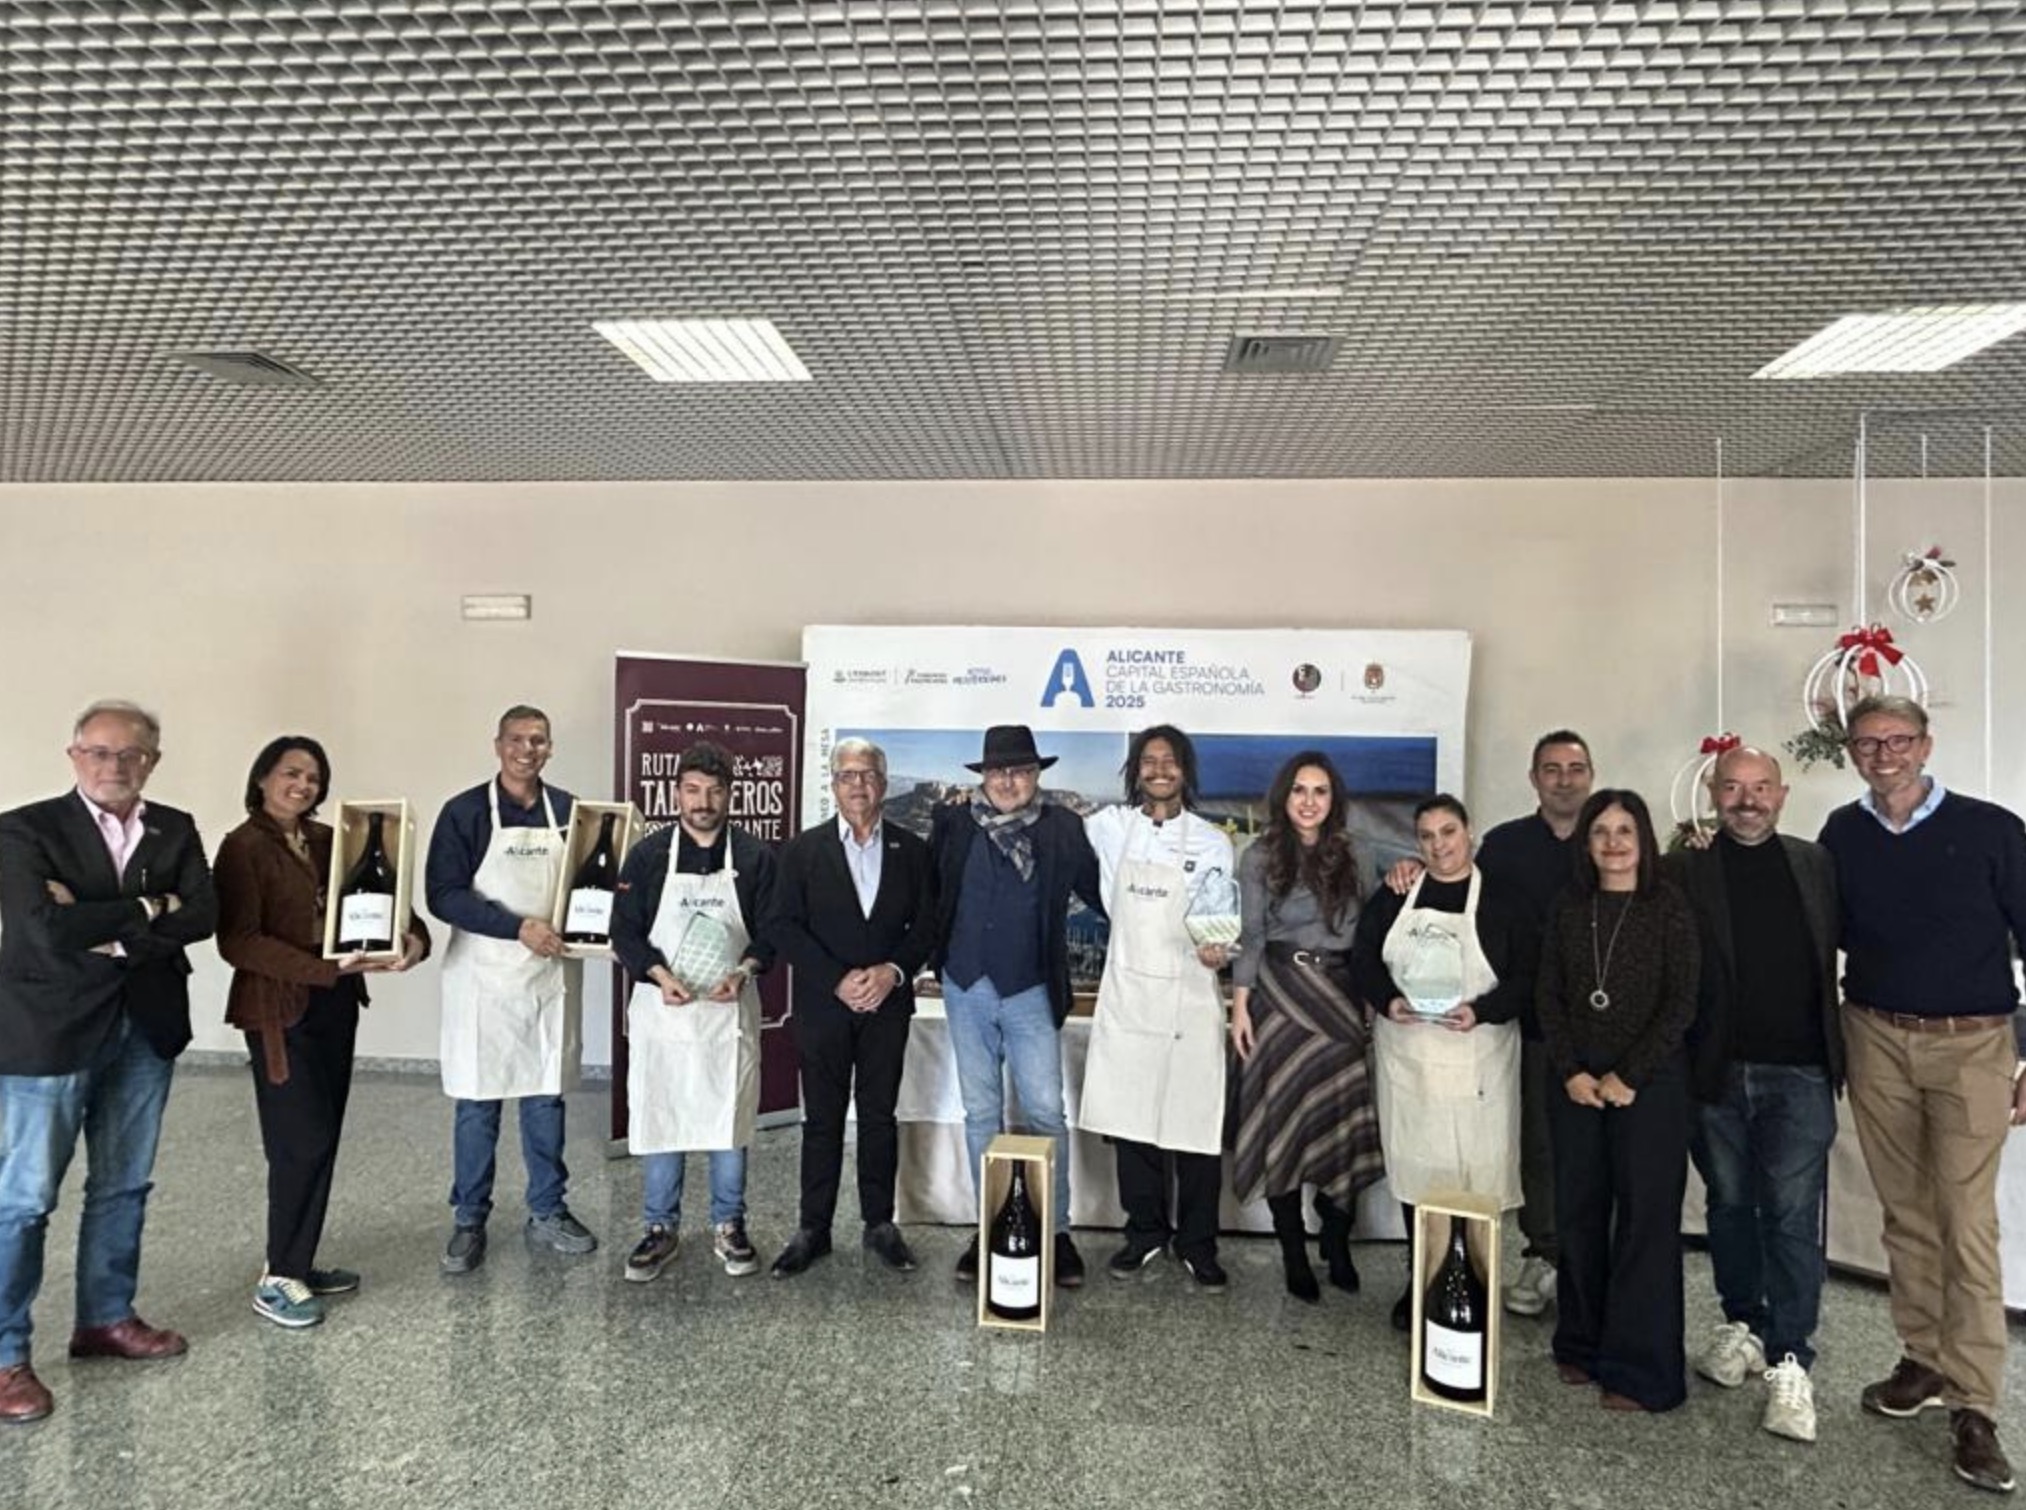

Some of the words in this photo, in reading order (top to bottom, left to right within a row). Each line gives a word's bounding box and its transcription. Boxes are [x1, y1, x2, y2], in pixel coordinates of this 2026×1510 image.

[1107, 650, 1186, 664] ALICANTE
[1106, 666, 1166, 679] CAPITAL
[1170, 665, 1250, 680] ESPAÑOLA
[1106, 680, 1127, 694] DE
[1130, 681, 1149, 694] LA
[1153, 680, 1265, 696] GASTRONOMÍA
[1106, 695, 1146, 708] 2025
